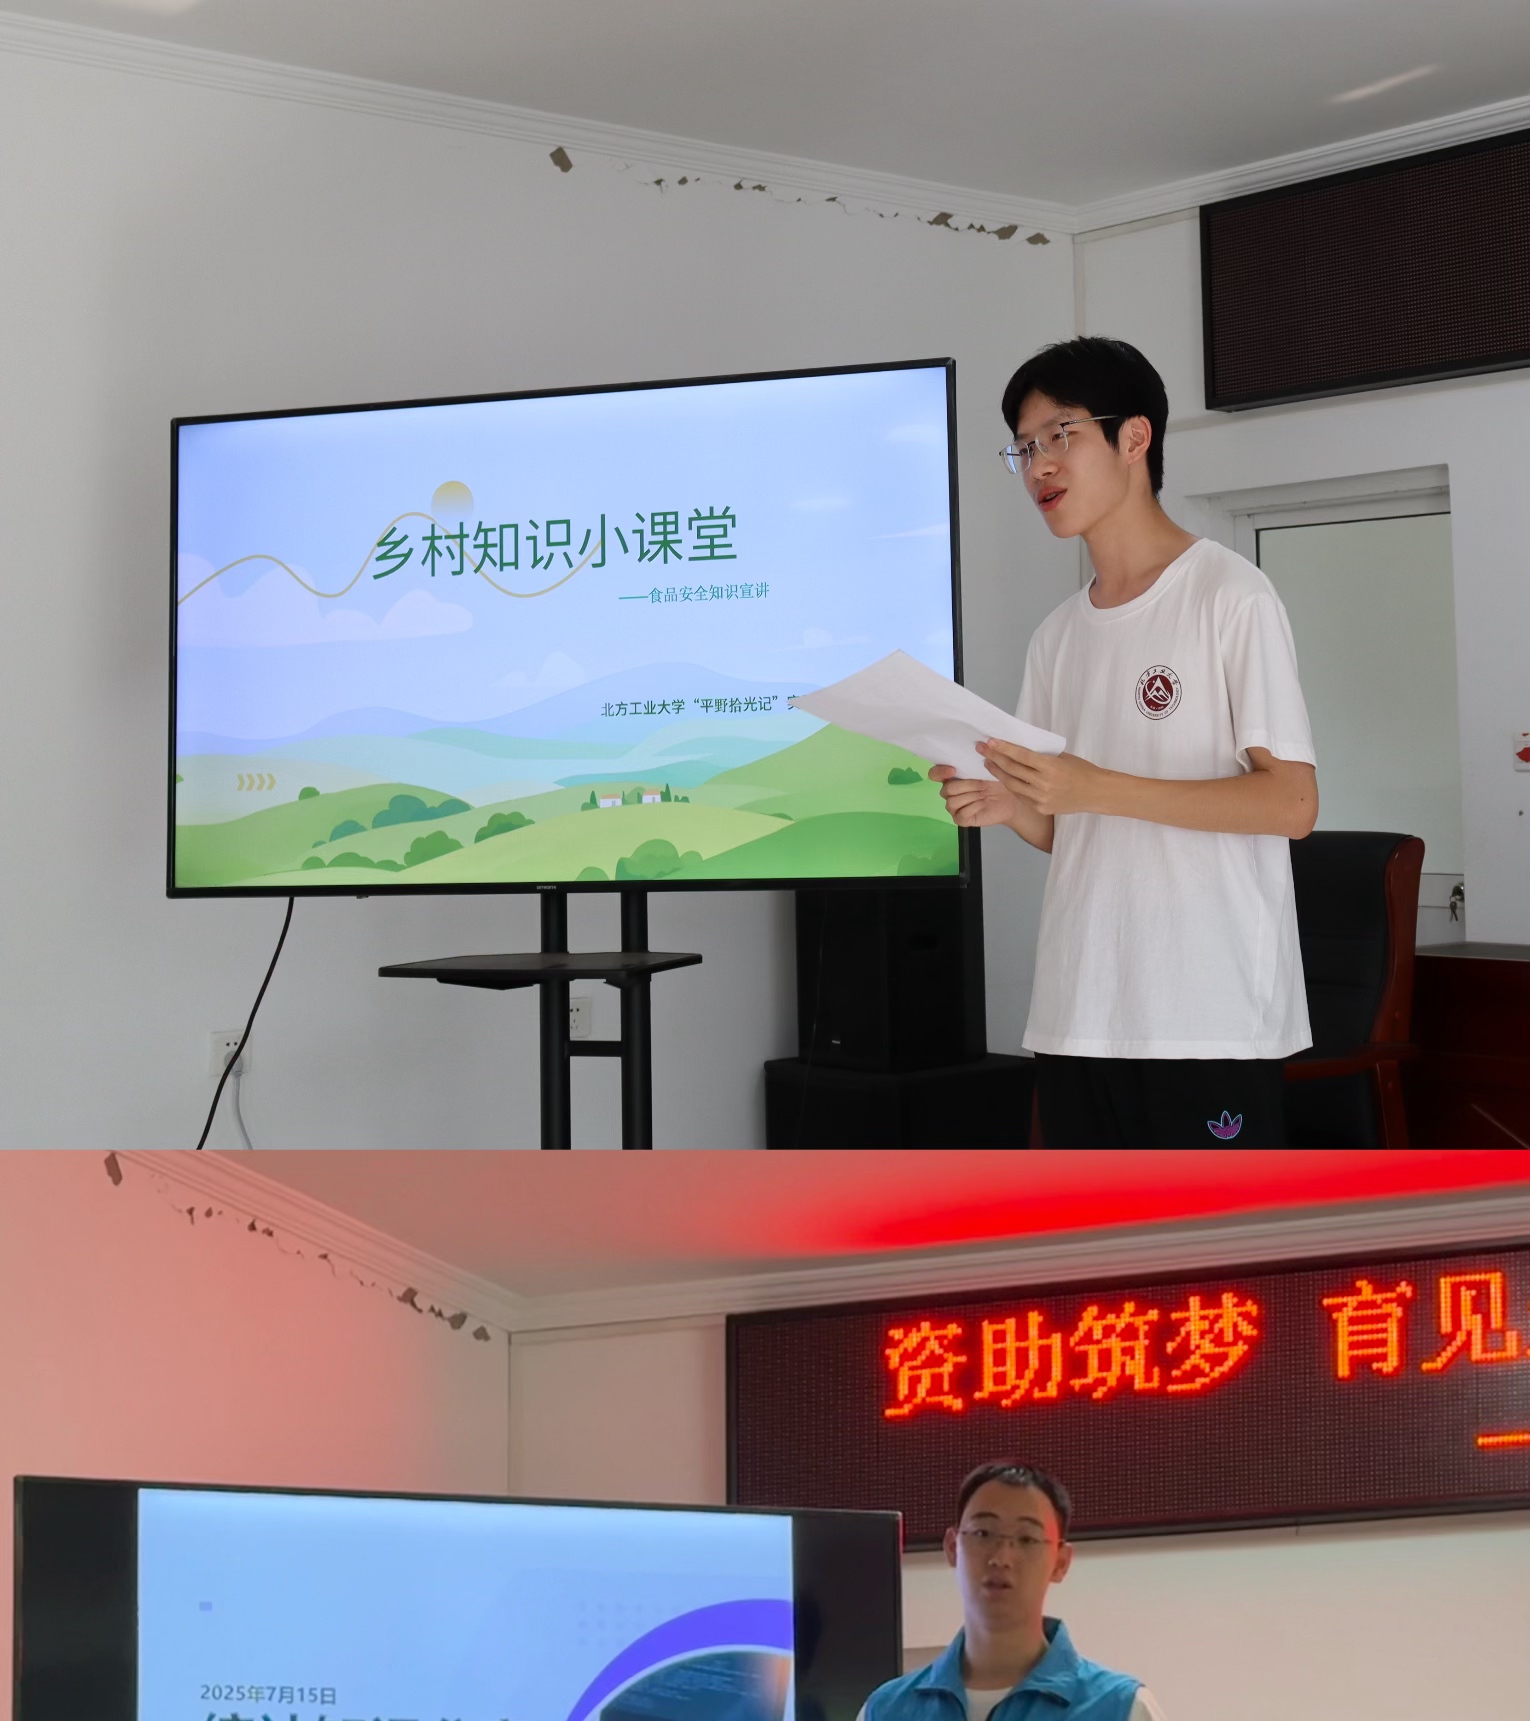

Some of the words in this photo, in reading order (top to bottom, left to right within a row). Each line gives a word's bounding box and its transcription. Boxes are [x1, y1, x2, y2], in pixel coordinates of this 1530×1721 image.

[372, 505, 738, 580] 乡村知识小课堂
[883, 1291, 1261, 1419] 资助筑梦
[1320, 1271, 1530, 1381] 育见
[200, 1684, 337, 1705] 2025年7月15日
